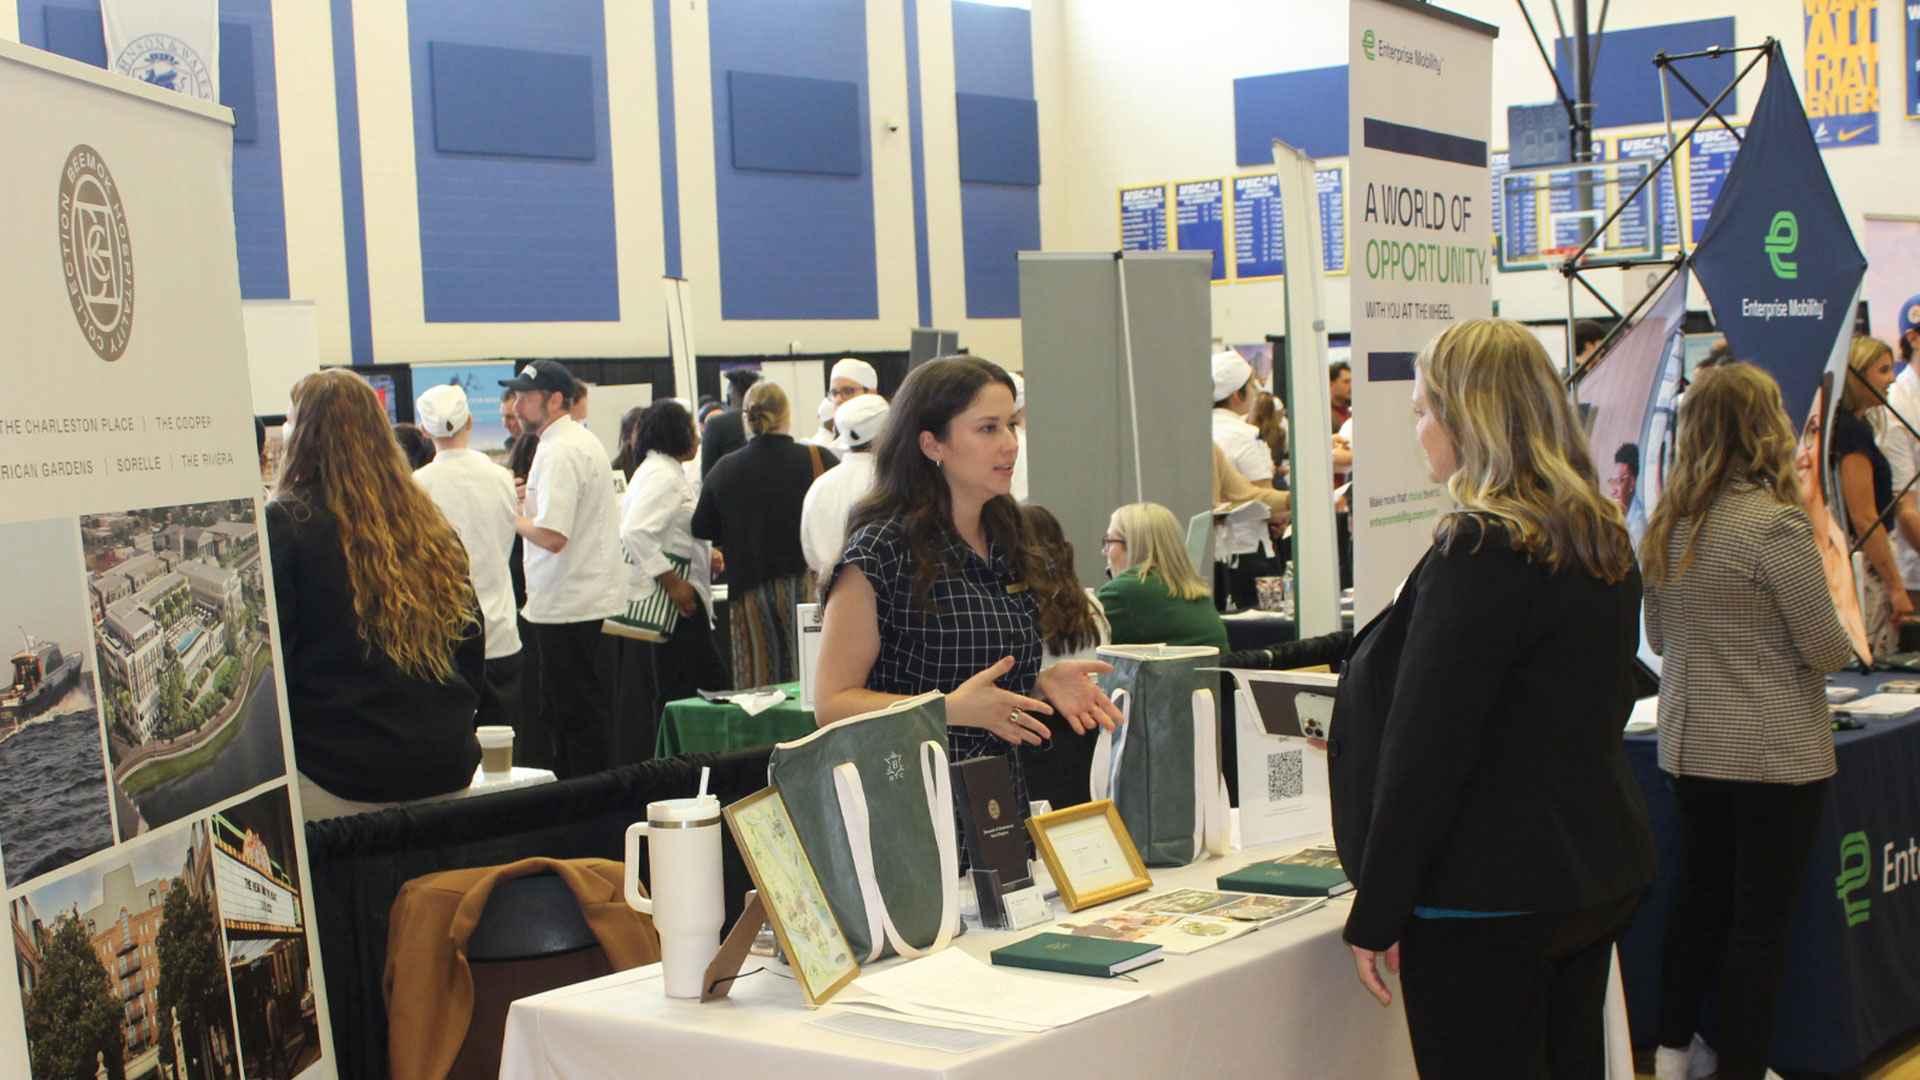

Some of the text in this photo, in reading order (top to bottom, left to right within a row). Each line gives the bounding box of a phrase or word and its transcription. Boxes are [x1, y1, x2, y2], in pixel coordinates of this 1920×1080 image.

[118, 38, 164, 74] HNSON
[1378, 40, 1442, 76] Enterprise Mobility
[1804, 54, 1879, 94] THAT
[1805, 89, 1879, 118] ENTER
[67, 152, 113, 195] BEEMOK
[1179, 181, 1219, 196] USCAA
[1313, 171, 1339, 183] CAA
[1123, 187, 1162, 201] USCAA
[1365, 182, 1378, 223] A
[1382, 184, 1446, 230] WORLD
[1451, 194, 1472, 232] OF
[61, 192, 104, 351] COLLECTION
[1366, 238, 1490, 285] OPPORTUNITY.
[112, 202, 133, 354] HOSPITALITY
[1366, 301, 1386, 318] WITH
[1388, 302, 1400, 319] YOU
[1402, 303, 1413, 319] AT
[1415, 303, 1427, 319] THE
[1742, 298, 1824, 321] Enterprise Mobility
[0, 416, 212, 434] THE CHARLESTON PLACE THE COOPER
[0, 453, 234, 480] RICAN GARDENS SORELLE THE RIVIERA
